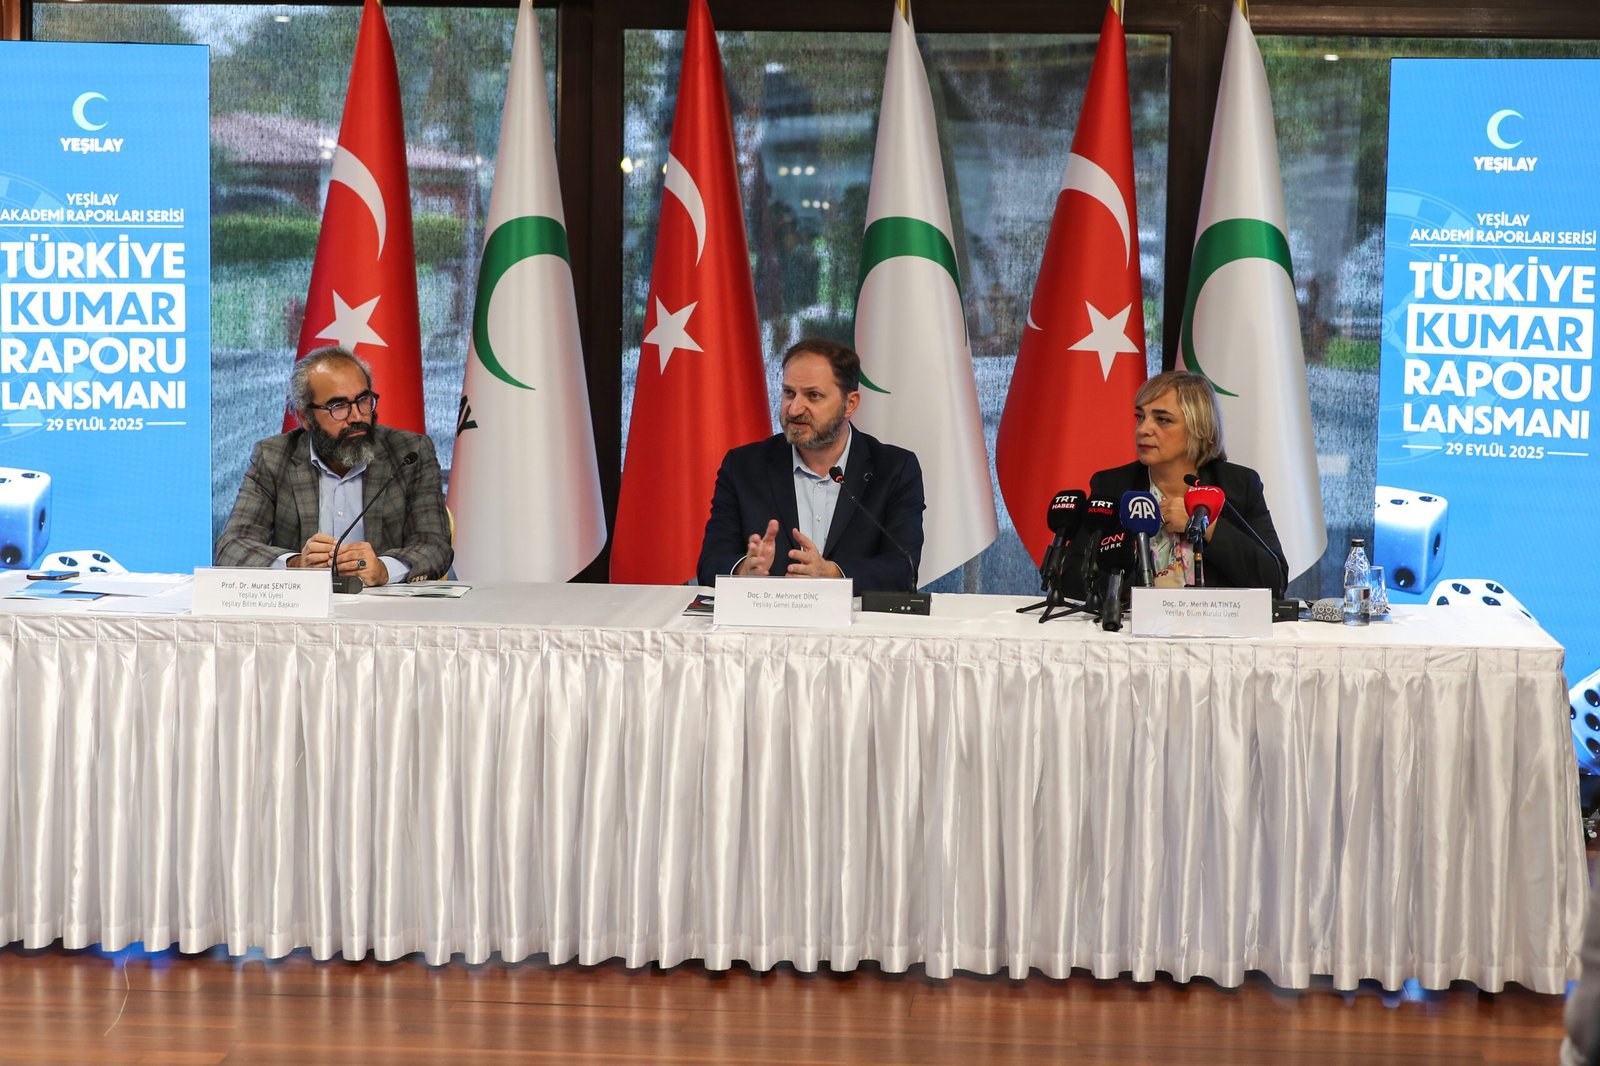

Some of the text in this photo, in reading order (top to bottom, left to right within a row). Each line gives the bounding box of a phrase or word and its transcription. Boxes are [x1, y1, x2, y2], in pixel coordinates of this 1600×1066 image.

[66, 191, 119, 208] YEŞİLAY
[0, 207, 185, 223] AKADEMİ RAPORLARI SERİSİ
[1477, 212, 1530, 228] YEŞİLAY
[1410, 227, 1597, 245] AKADEMİ RAPORLARI SERİSİ
[0, 233, 186, 279] TÜRKİYE
[1409, 253, 1596, 303] TÜRKİYE
[10, 291, 176, 326] KUMAR
[1416, 312, 1584, 352] KUMAR
[0, 337, 186, 374] RAPORU
[1404, 358, 1592, 402] RAPORU
[2, 380, 186, 410] LANSMANI
[46, 416, 143, 431] 29 EYLÜL 2025
[1403, 403, 1590, 439] LANSMANI
[1445, 442, 1544, 459] 29 EYLÜL 2025
[1055, 495, 1078, 503] TRT
[1090, 500, 1113, 509] TRT
[1129, 502, 1156, 519] AA
[1100, 532, 1125, 546] CNN
[221, 581, 237, 589] Prof.
[271, 582, 302, 591] ŞENTÜRK
[747, 591, 819, 601] Doç. Dr. Mehmet DİNÇ
[1162, 600, 1176, 608] Doç.
[1178, 600, 1189, 608] Dr.
[1210, 601, 1241, 609] ALTINTAŞ
